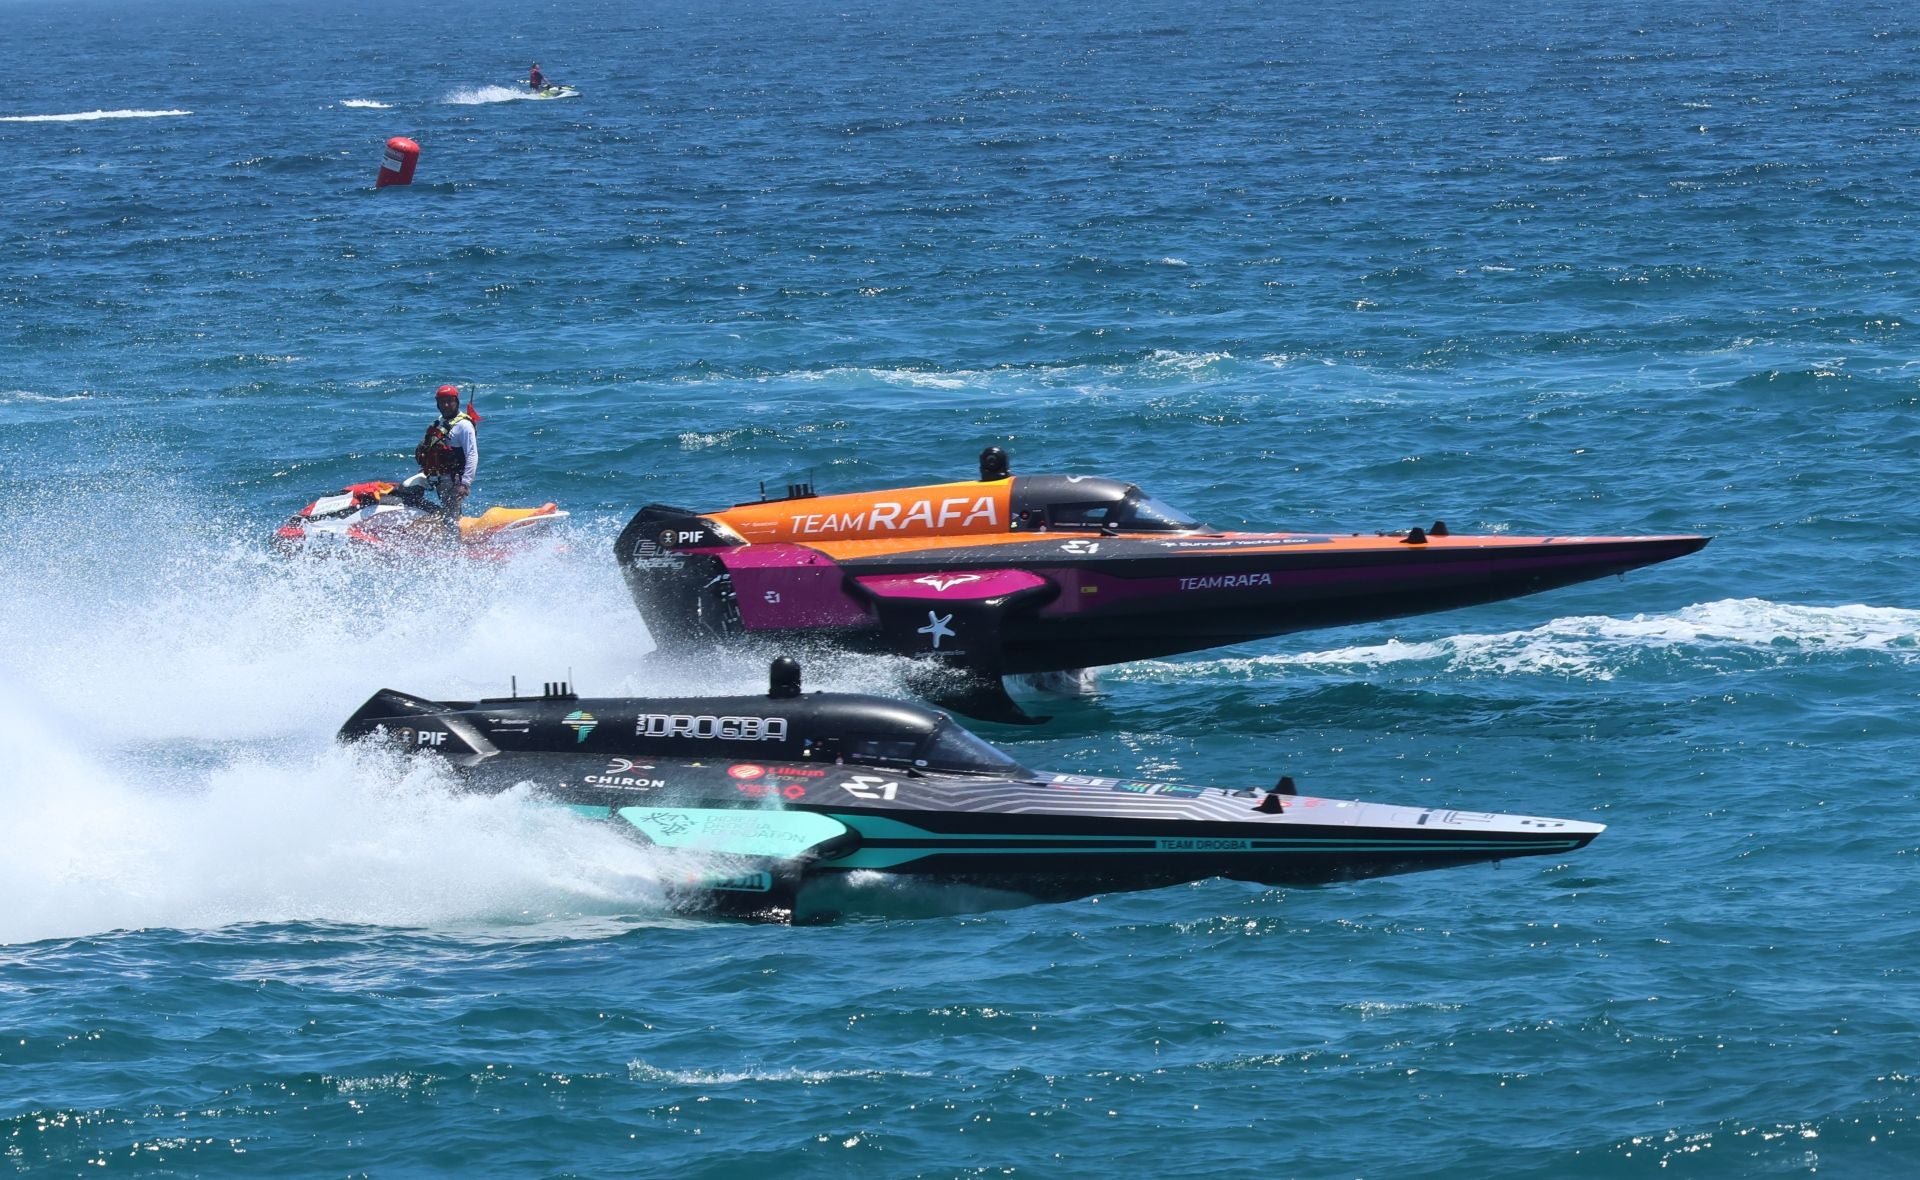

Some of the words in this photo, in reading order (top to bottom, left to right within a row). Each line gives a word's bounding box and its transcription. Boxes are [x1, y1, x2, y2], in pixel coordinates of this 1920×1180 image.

[791, 512, 866, 534] TEAM
[867, 496, 998, 531] RAFA
[678, 530, 705, 544] PIF
[1179, 576, 1223, 590] TEAM
[1223, 573, 1272, 588] RAFA
[635, 713, 647, 736] TEAM
[645, 713, 788, 742] DROGBA
[417, 730, 449, 746] PIF
[584, 775, 665, 789] CHIRON
[1161, 840, 1193, 850] TEAM
[1198, 840, 1247, 850] DROGBA
